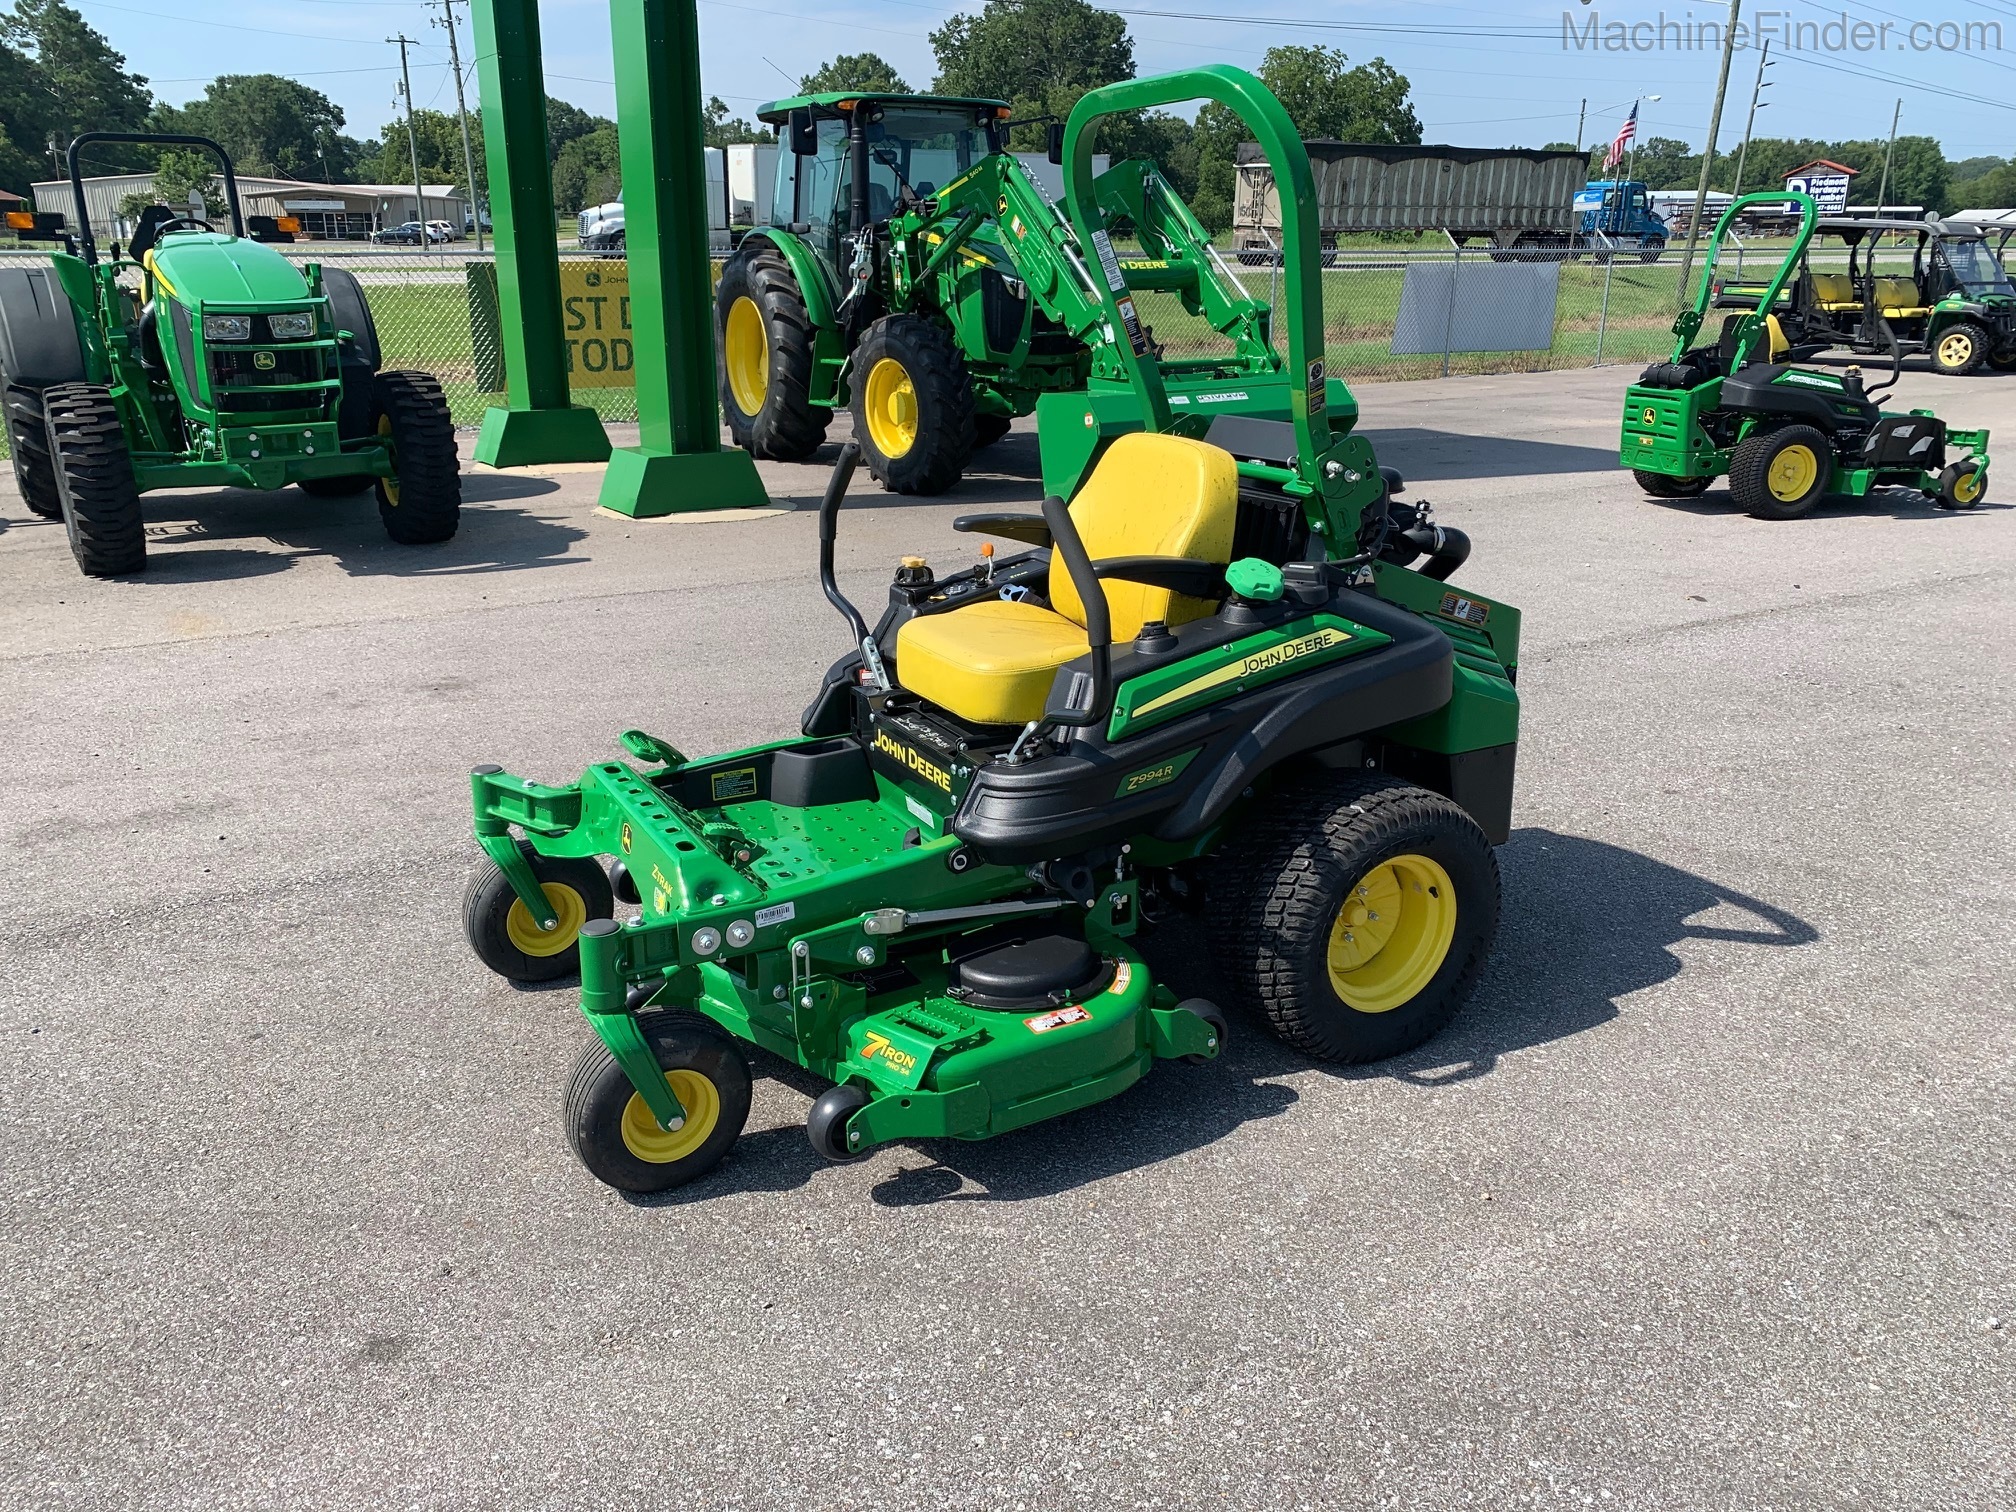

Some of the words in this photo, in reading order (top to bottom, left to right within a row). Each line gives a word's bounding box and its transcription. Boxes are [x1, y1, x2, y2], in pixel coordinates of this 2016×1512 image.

[1810, 178, 1848, 187] Piedmont
[1809, 186, 1847, 194] Hardware
[1816, 193, 1845, 202] Lumber
[1128, 260, 1169, 270] DEERE
[604, 275, 629, 284] JOHN
[566, 338, 634, 373] TOD
[1240, 652, 1281, 677] JOHN
[1284, 633, 1333, 660] DEERE
[874, 728, 906, 764] JOHN
[908, 747, 951, 792] DEERE
[885, 1060, 900, 1071] PRO
